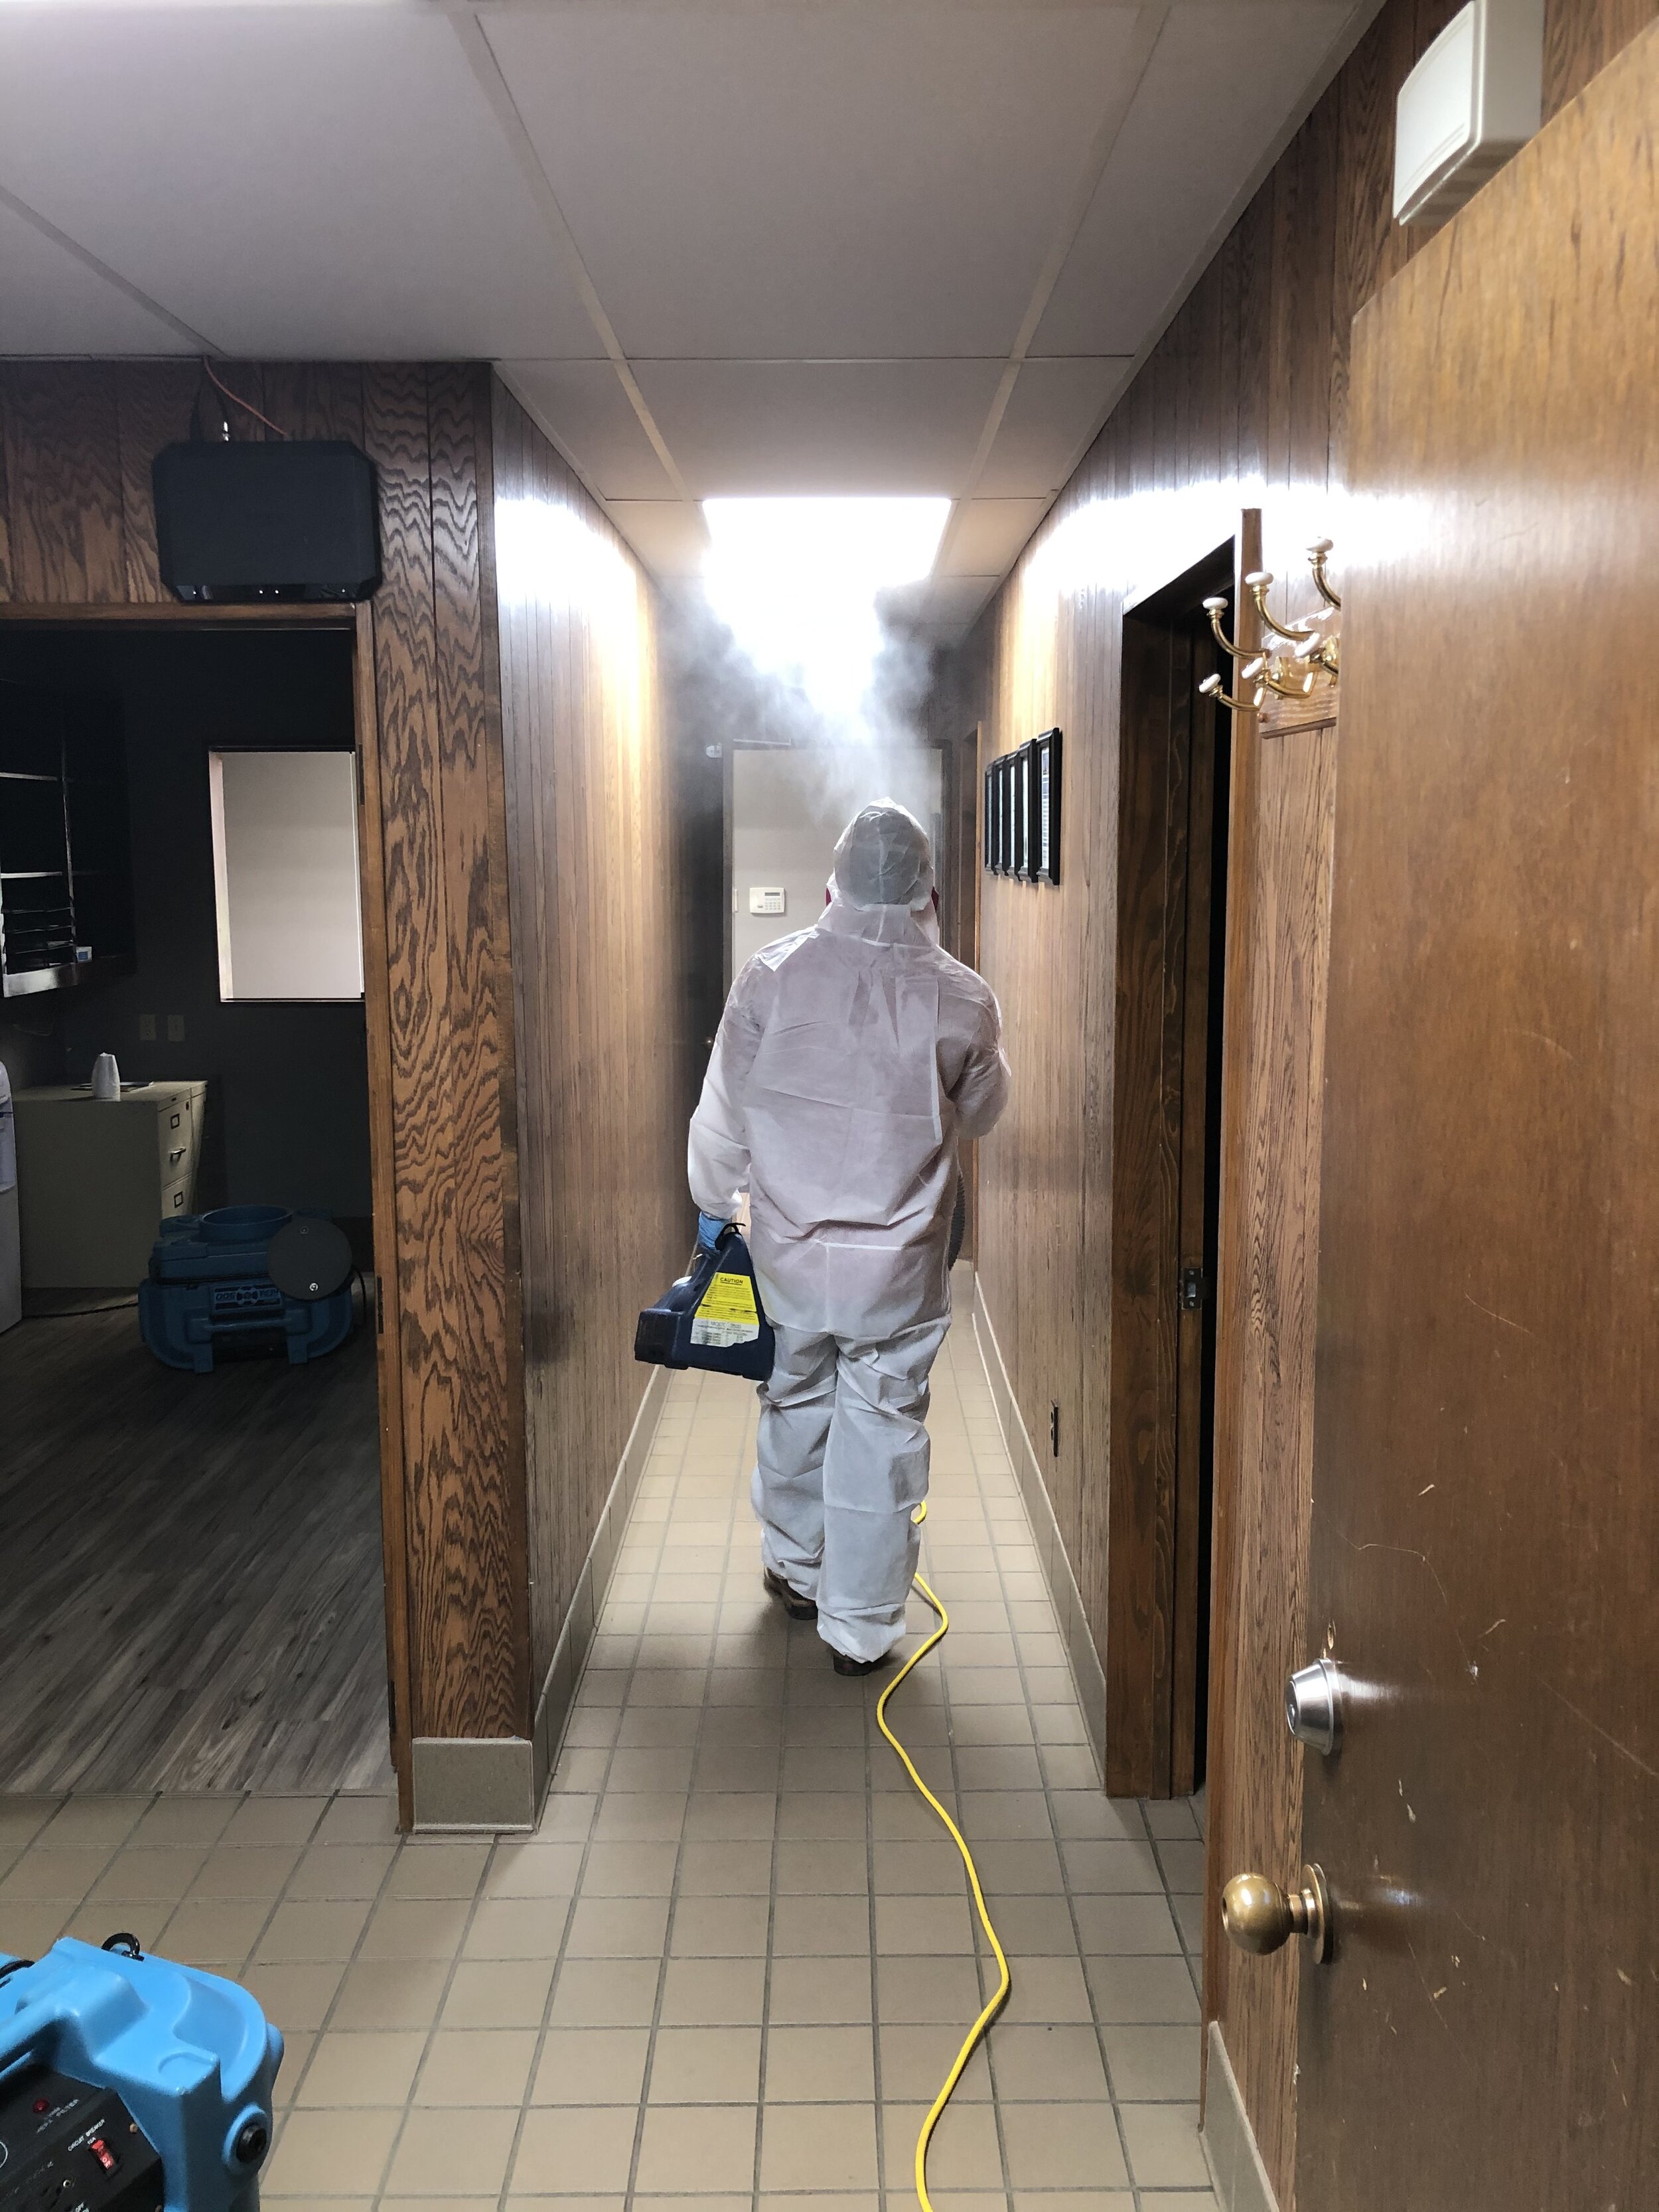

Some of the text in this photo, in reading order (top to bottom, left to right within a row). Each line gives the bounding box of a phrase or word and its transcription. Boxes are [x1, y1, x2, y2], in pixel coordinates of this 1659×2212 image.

[216, 1292, 236, 1301] 500
[56, 2099, 80, 2117] FILTER
[68, 2119, 105, 2151] CIRCUIT BREAKER
